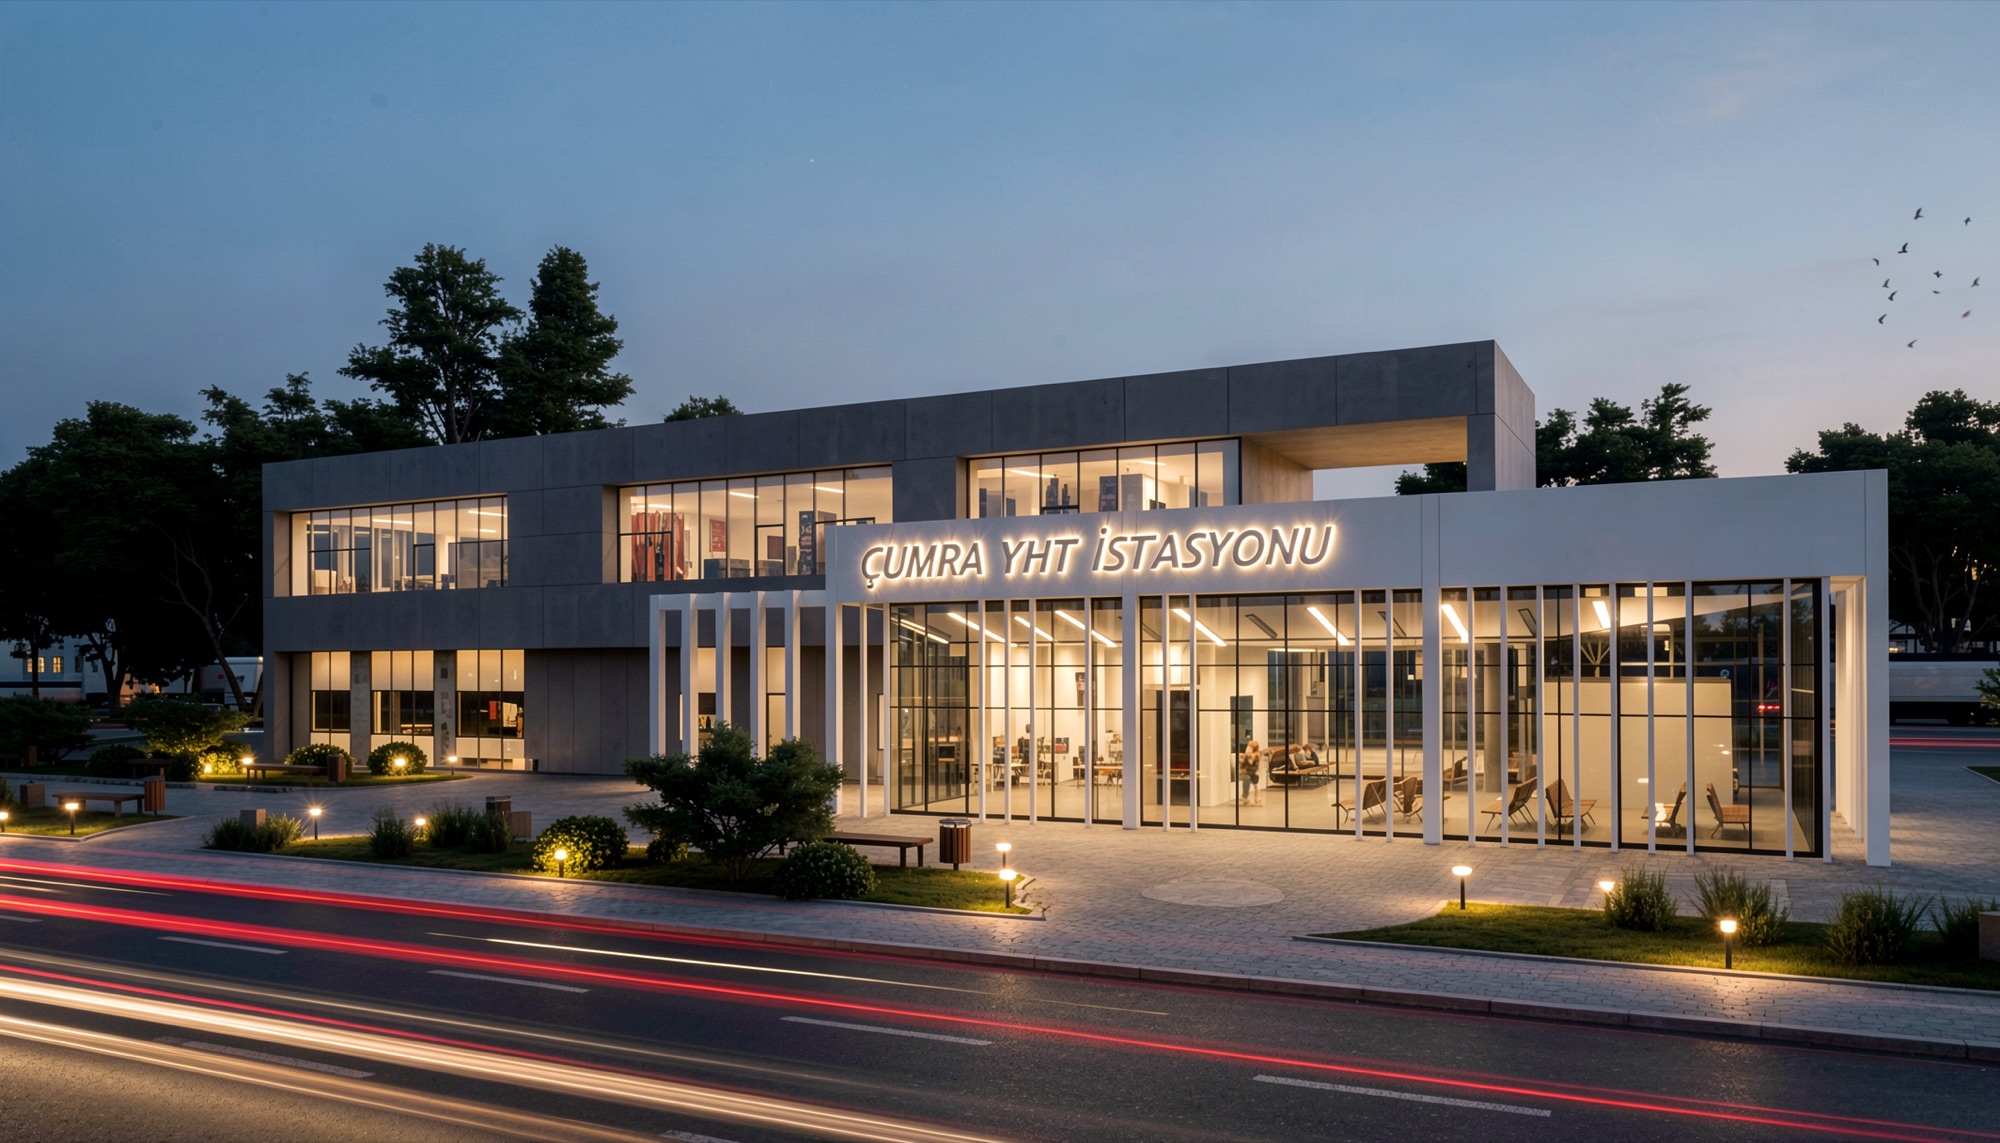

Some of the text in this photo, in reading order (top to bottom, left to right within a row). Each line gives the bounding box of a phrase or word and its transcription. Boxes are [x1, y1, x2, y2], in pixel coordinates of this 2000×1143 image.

[861, 526, 1332, 589] ÇUMRA YHT İSTASYONU
